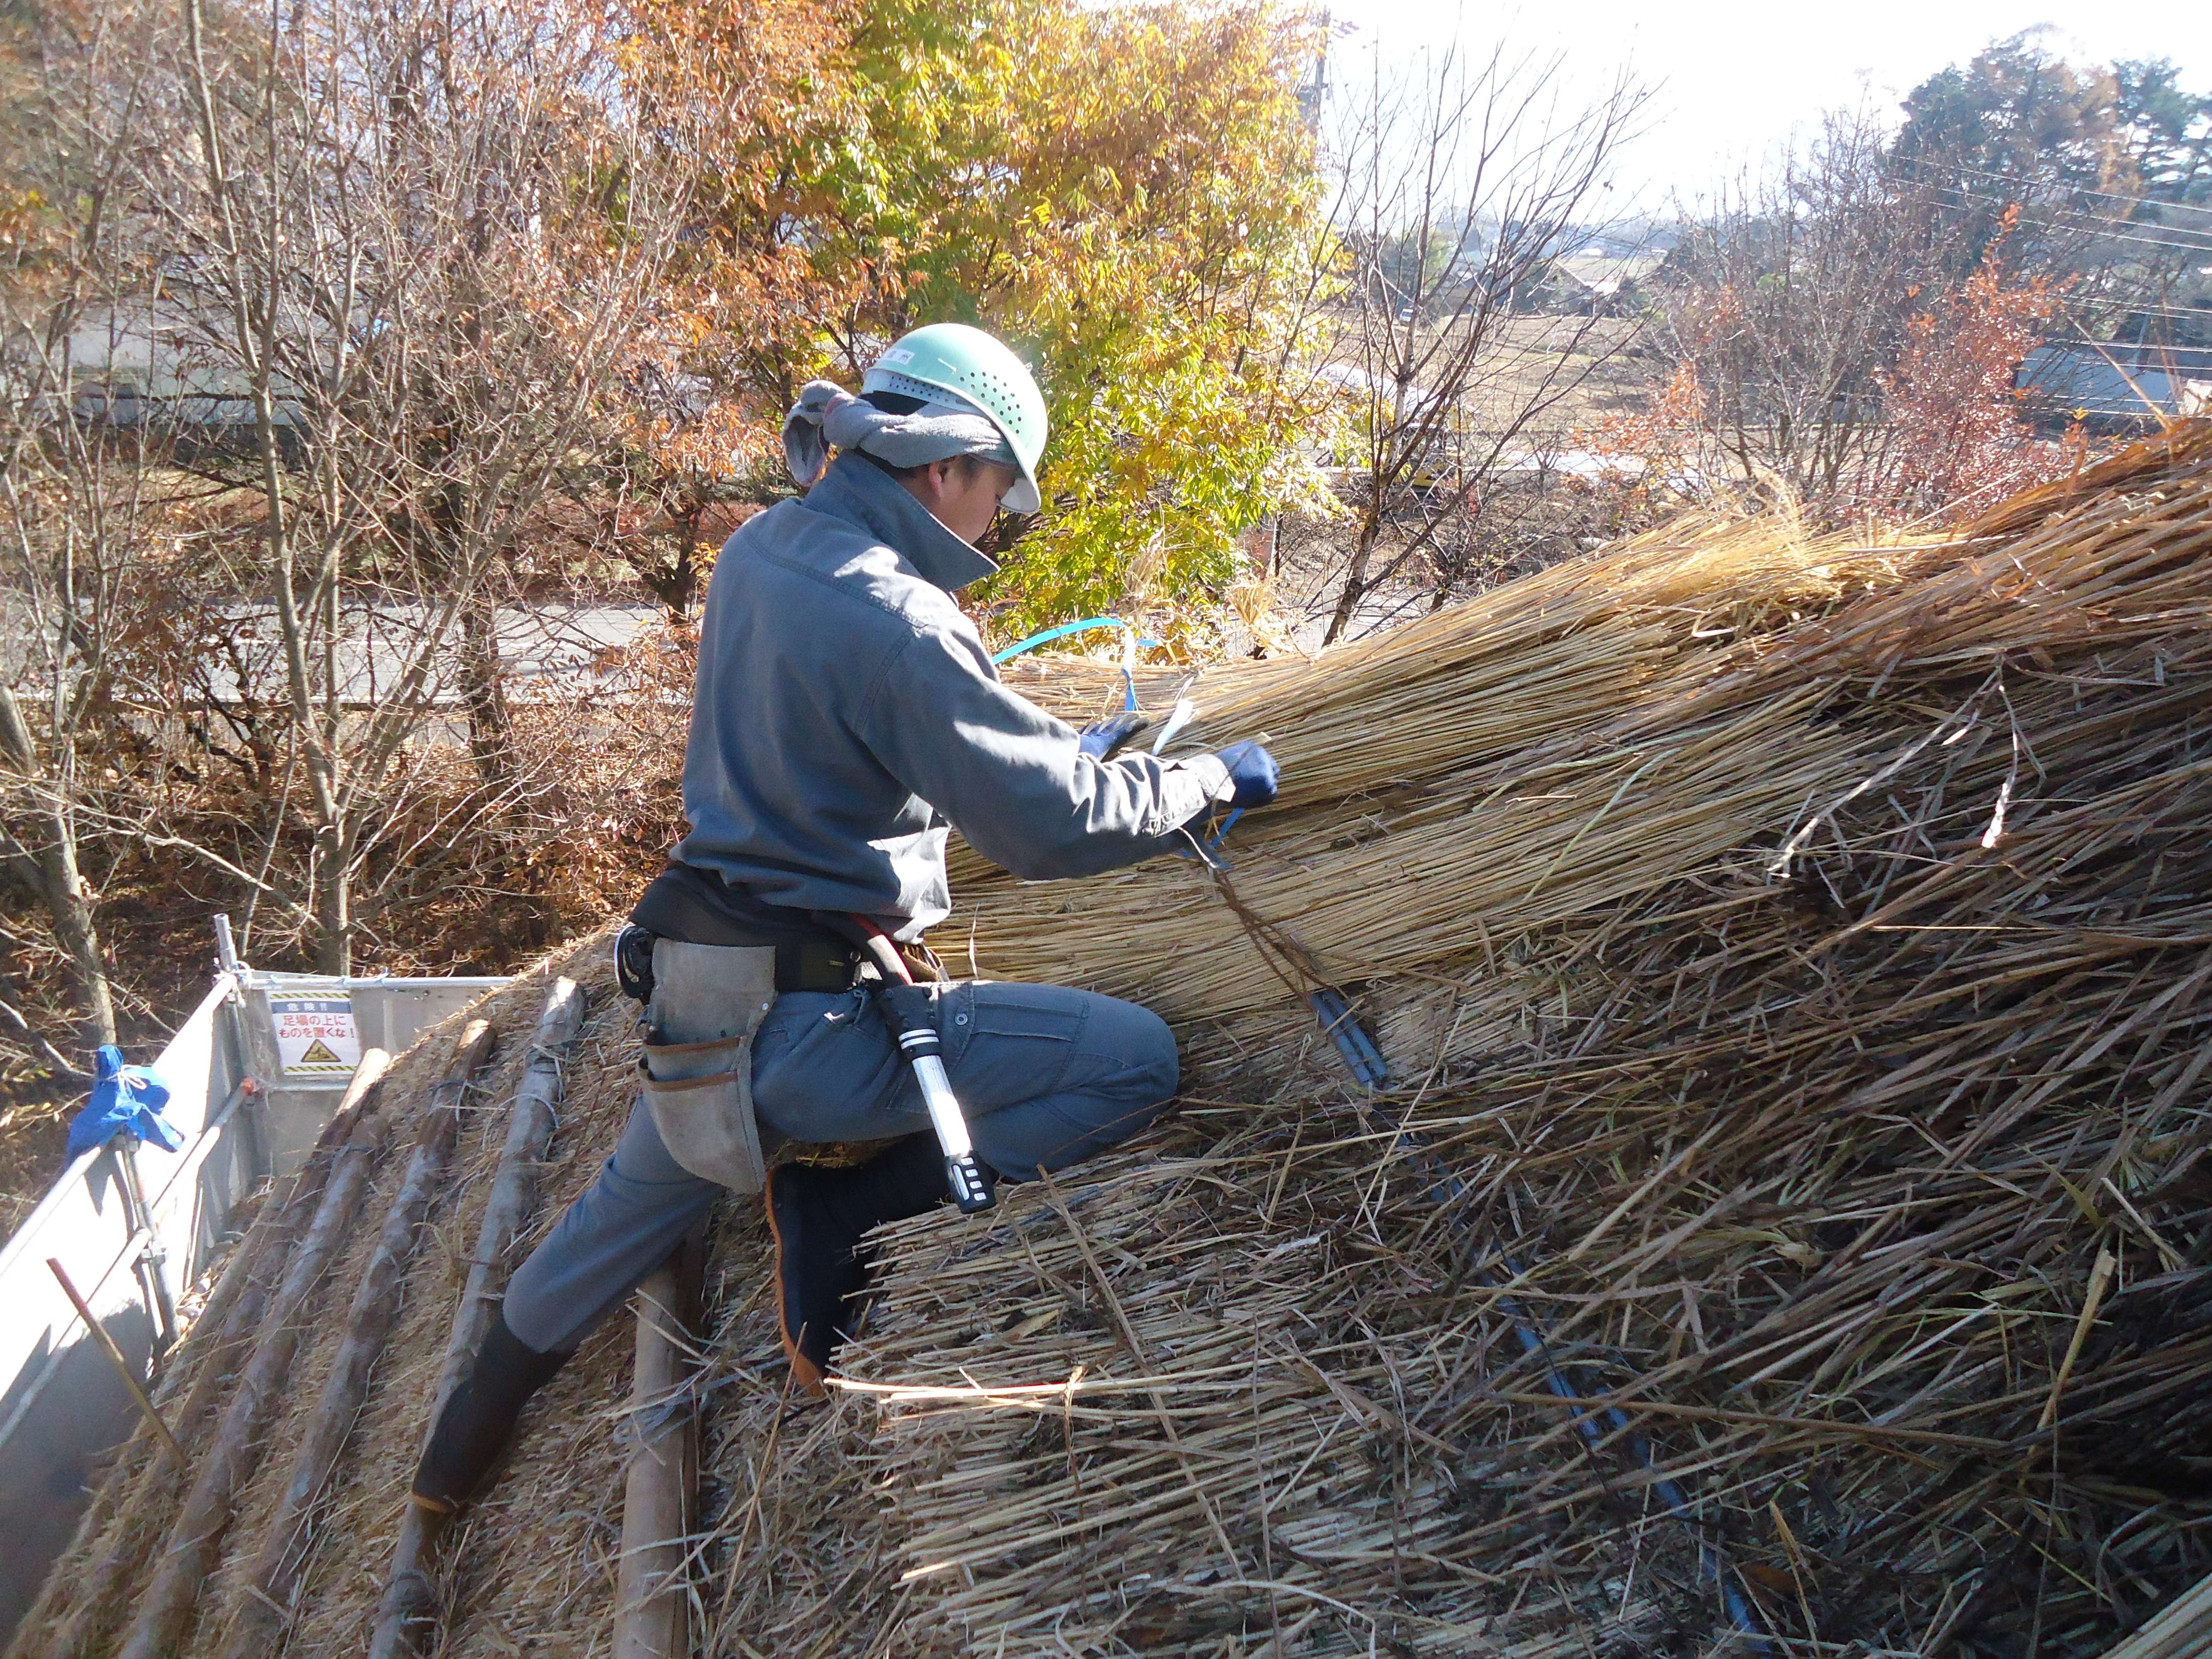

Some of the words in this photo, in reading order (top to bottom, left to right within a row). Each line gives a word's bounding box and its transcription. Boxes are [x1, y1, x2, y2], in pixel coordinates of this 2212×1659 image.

[283, 1015, 346, 1026] 足場の上に
